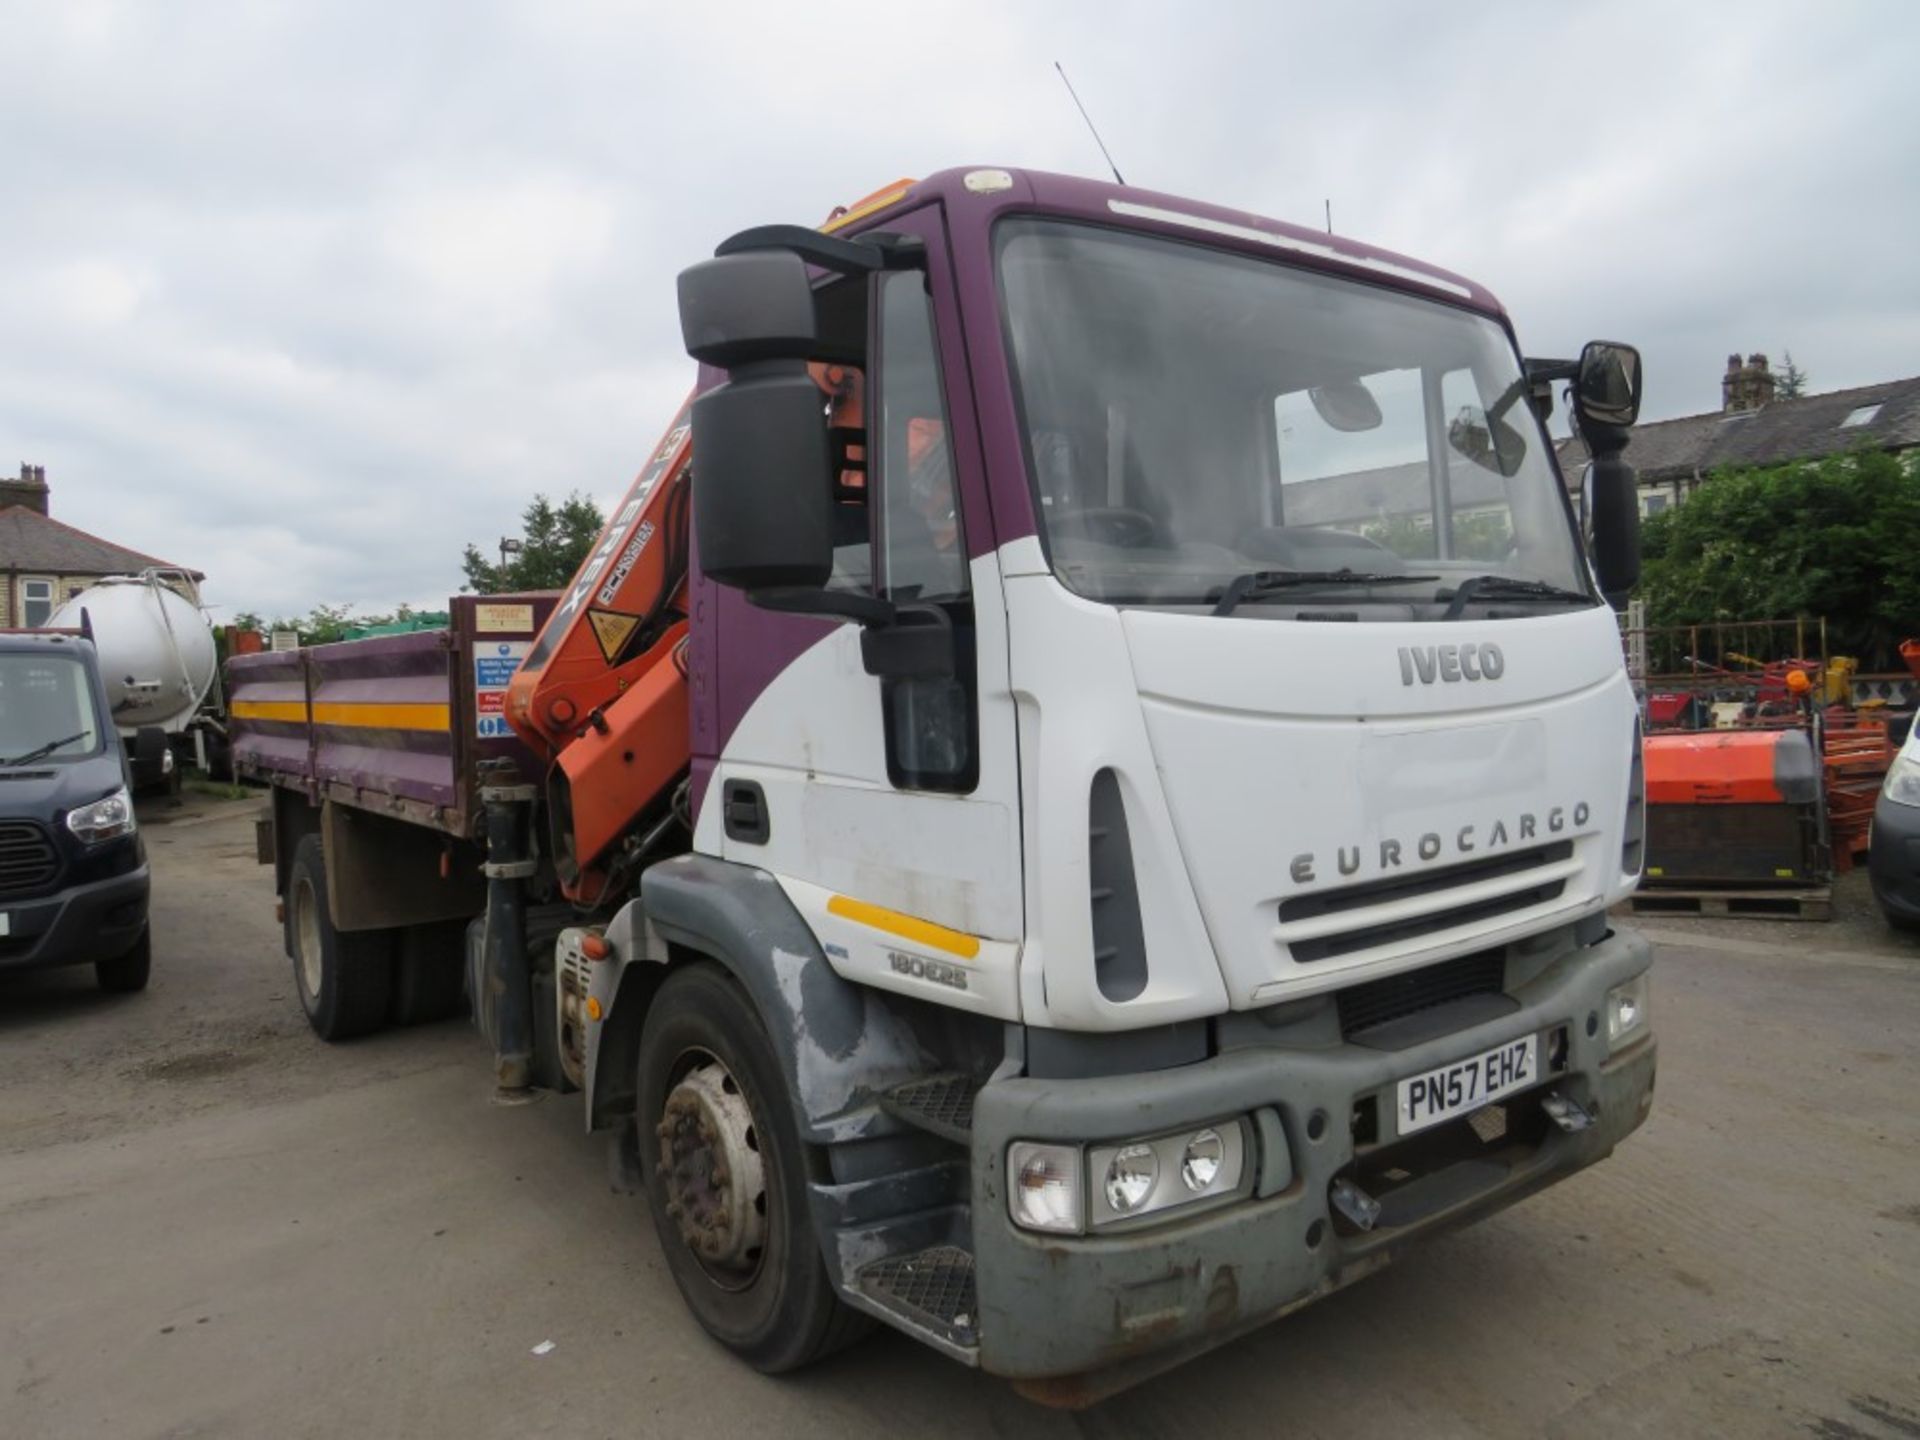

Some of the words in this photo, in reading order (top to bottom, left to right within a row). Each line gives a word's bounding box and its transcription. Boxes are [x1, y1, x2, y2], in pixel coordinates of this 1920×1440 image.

[560, 468, 662, 617] TEREX
[1398, 643, 1504, 686] IVECO
[1289, 801, 1591, 884] EUROCARGO
[887, 951, 969, 991] 180E25
[1409, 1061, 1479, 1122] PN57
[1485, 1041, 1528, 1093] EHZ
